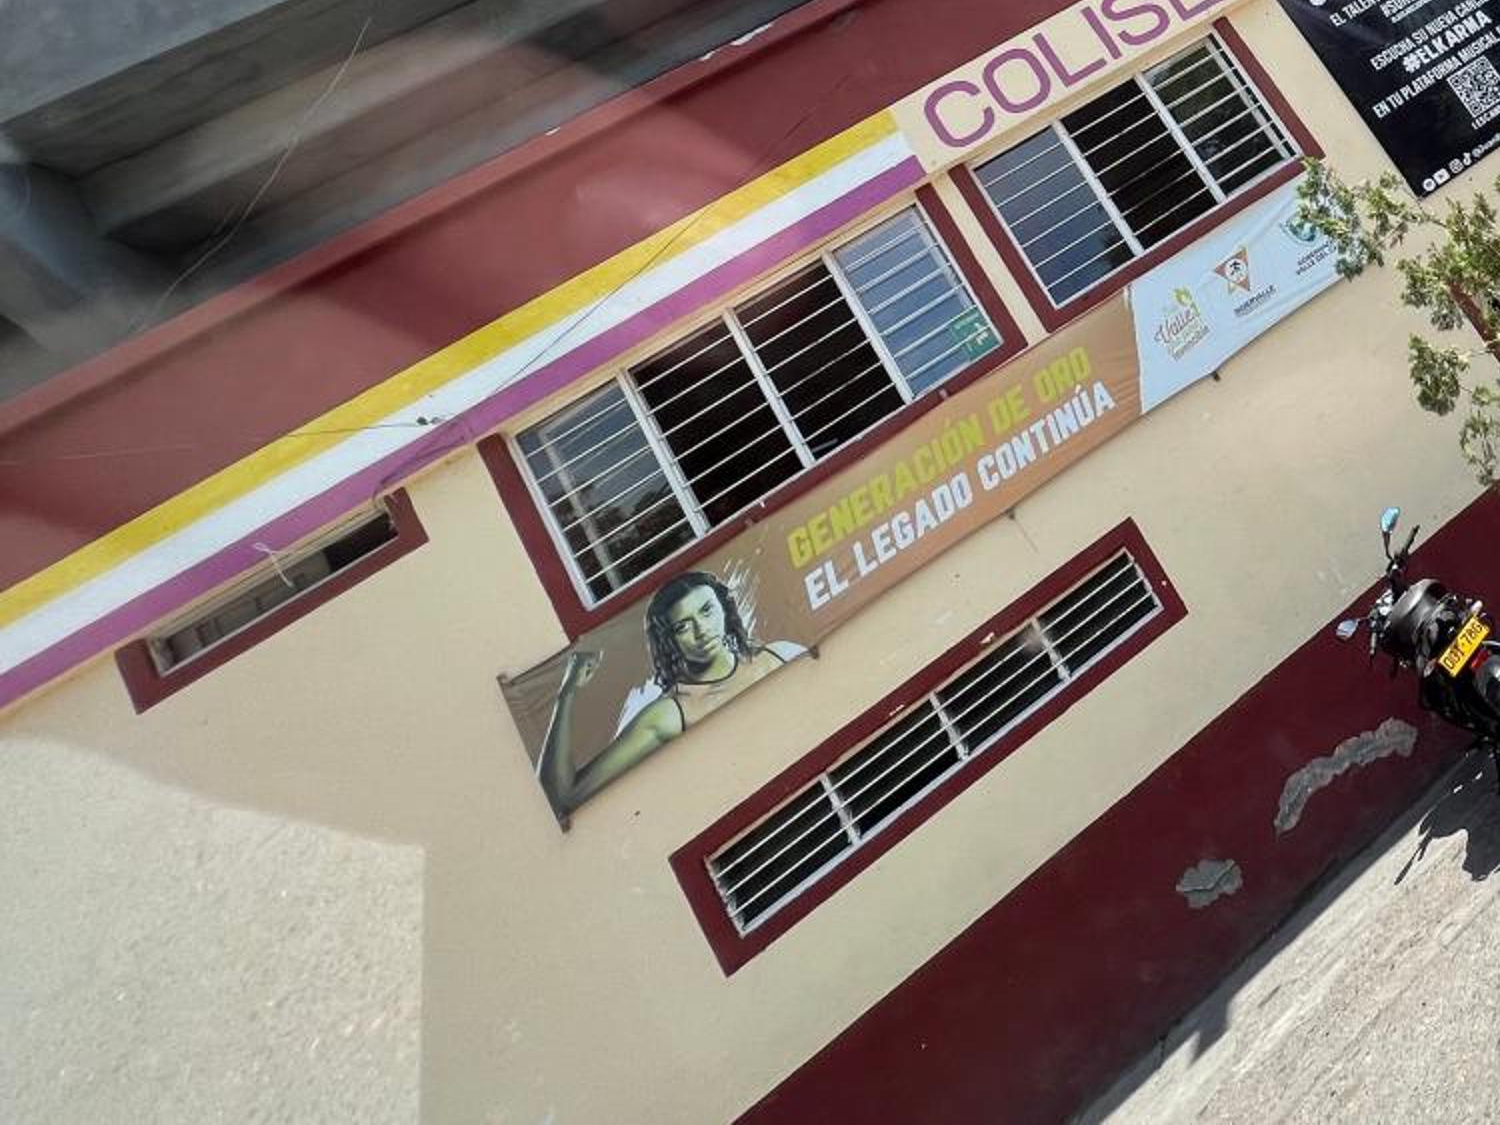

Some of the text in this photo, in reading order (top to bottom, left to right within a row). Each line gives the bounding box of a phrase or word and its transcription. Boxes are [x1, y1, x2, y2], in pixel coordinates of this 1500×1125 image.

[1329, 12, 1347, 27] EL
[1369, 37, 1417, 71] ESCUCHA
[1411, 27, 1429, 44] SU
[1425, 10, 1459, 36] NUEVA
[1402, 9, 1493, 73] #ELKARMA
[1372, 103, 1391, 119] EN
[1386, 90, 1405, 109] TU
[1399, 55, 1463, 101] PLATAFORMA
[1457, 31, 1500, 64] MUSICAL
[786, 346, 1091, 568] GENERACIÓN DE ORO
[804, 379, 1116, 611] EL LEGADO CONTINÚA
